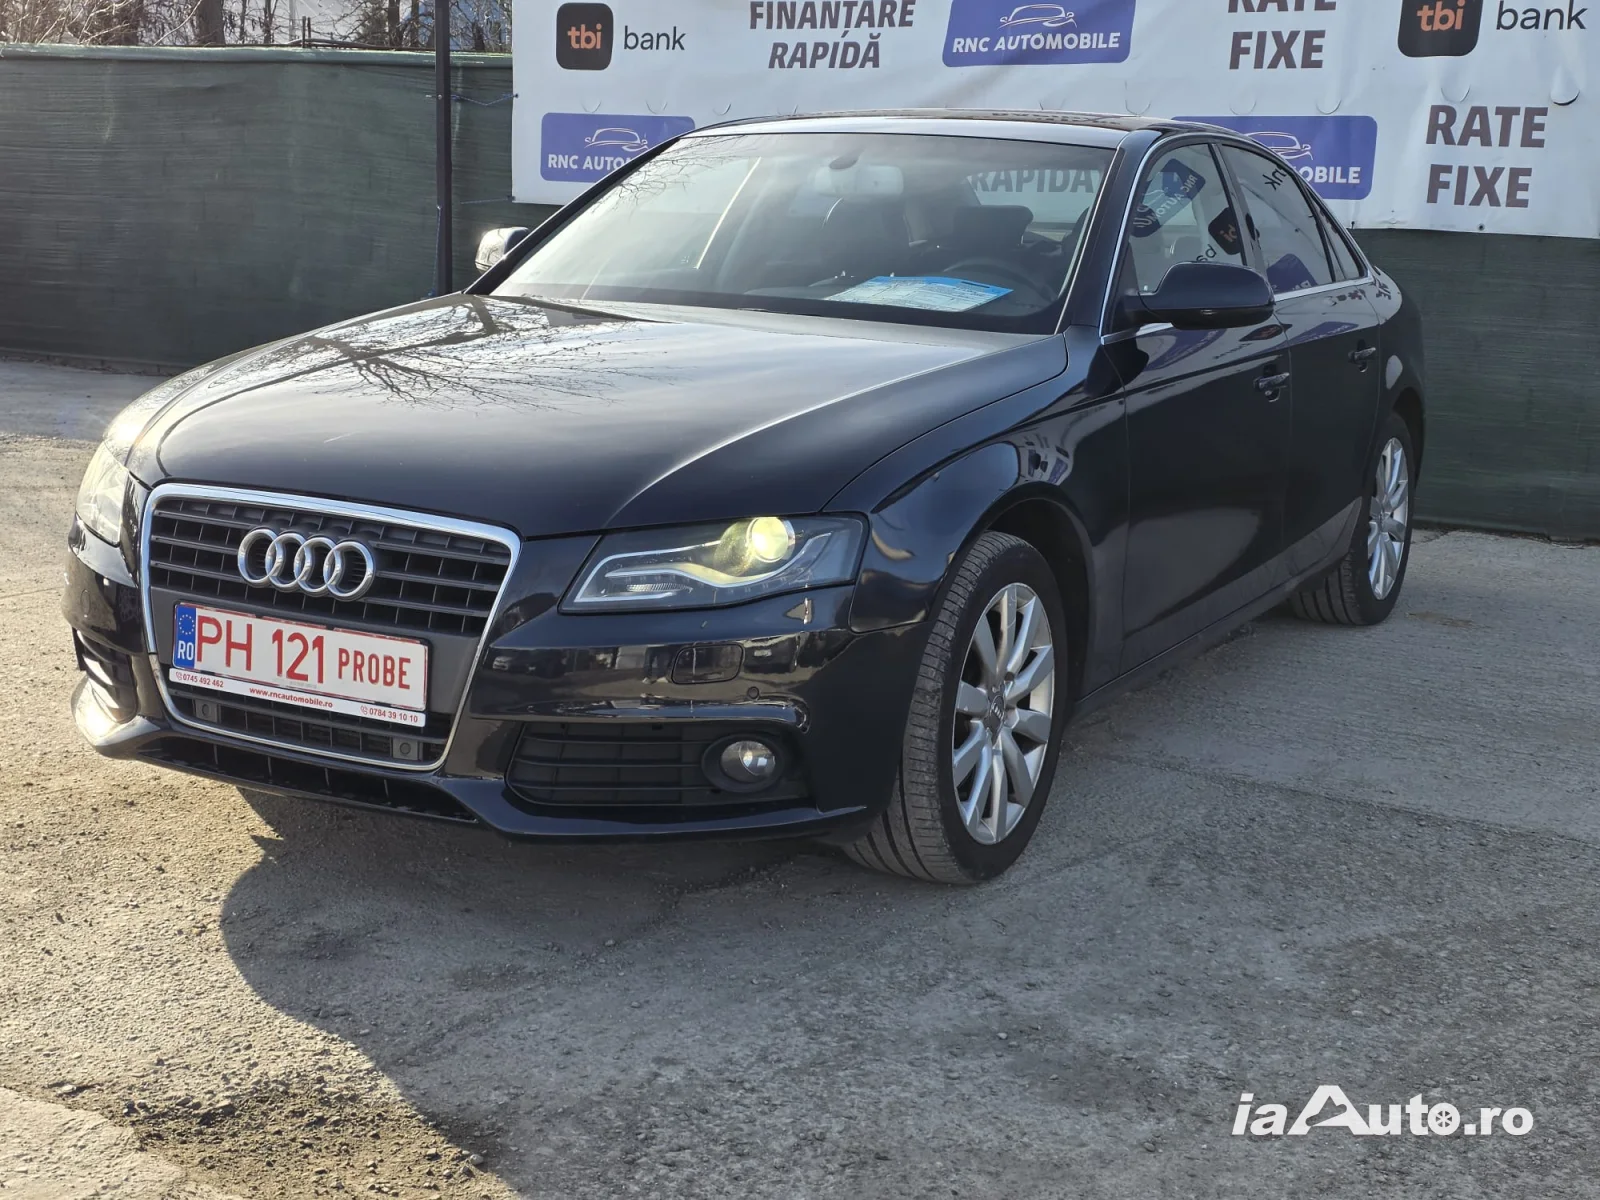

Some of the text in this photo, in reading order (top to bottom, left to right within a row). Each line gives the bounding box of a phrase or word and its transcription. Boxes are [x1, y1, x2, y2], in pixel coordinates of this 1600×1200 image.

[1416, 0, 1588, 31] tbi bank
[567, 23, 686, 50] tbi bank
[952, 32, 1121, 53] RNC AUTOMOBILE
[1229, 30, 1326, 69] FIXE
[768, 33, 882, 69] RAPIDĂ
[1426, 105, 1548, 148] RATE
[548, 154, 579, 169] RNC
[1426, 164, 1532, 208] FIXE
[178, 640, 194, 660] RO
[197, 615, 411, 689] PH 121 PROBE
[182, 674, 198, 683] 0745
[249, 686, 333, 708] www.rncautomobile.ro
[369, 707, 418, 723] 0784 39 10 10
